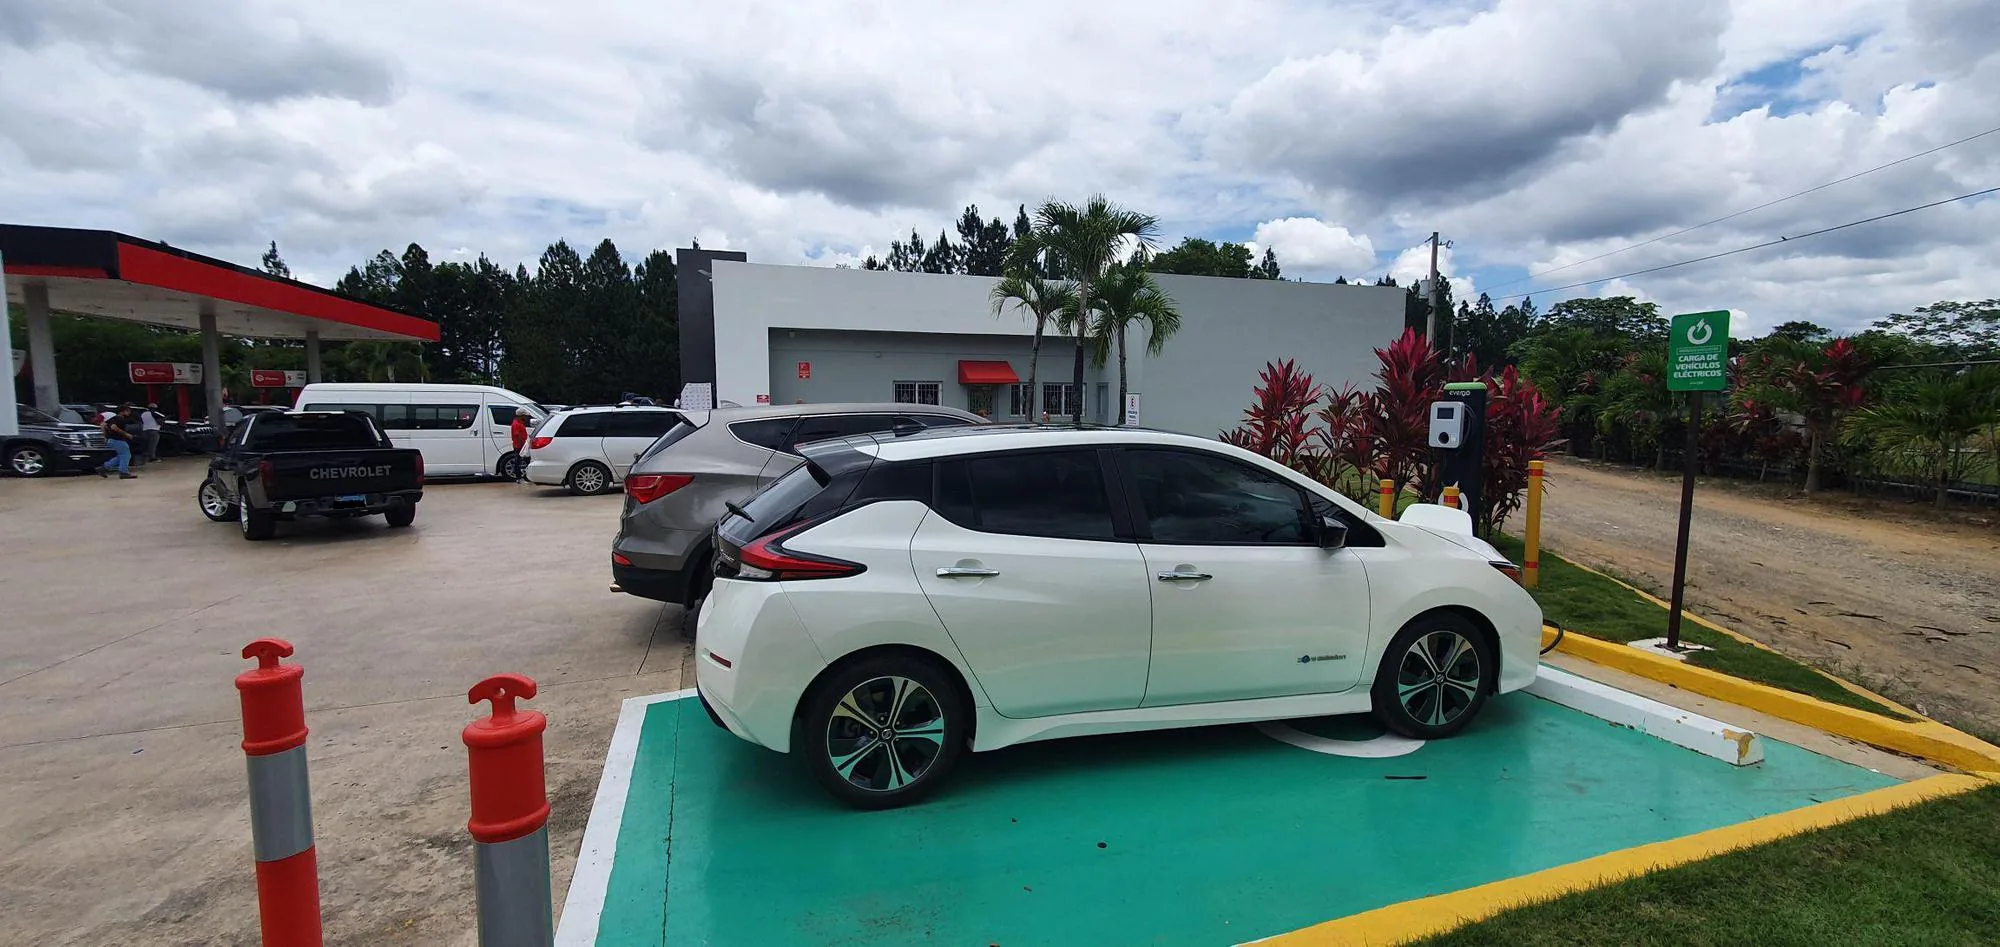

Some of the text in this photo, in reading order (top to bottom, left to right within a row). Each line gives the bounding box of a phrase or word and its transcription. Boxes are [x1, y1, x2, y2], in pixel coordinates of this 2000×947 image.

[1675, 362, 1720, 370] VEHÍCULOS
[1673, 370, 1721, 378] ELÉCTRICOS
[309, 465, 392, 479] CHEVROLET
